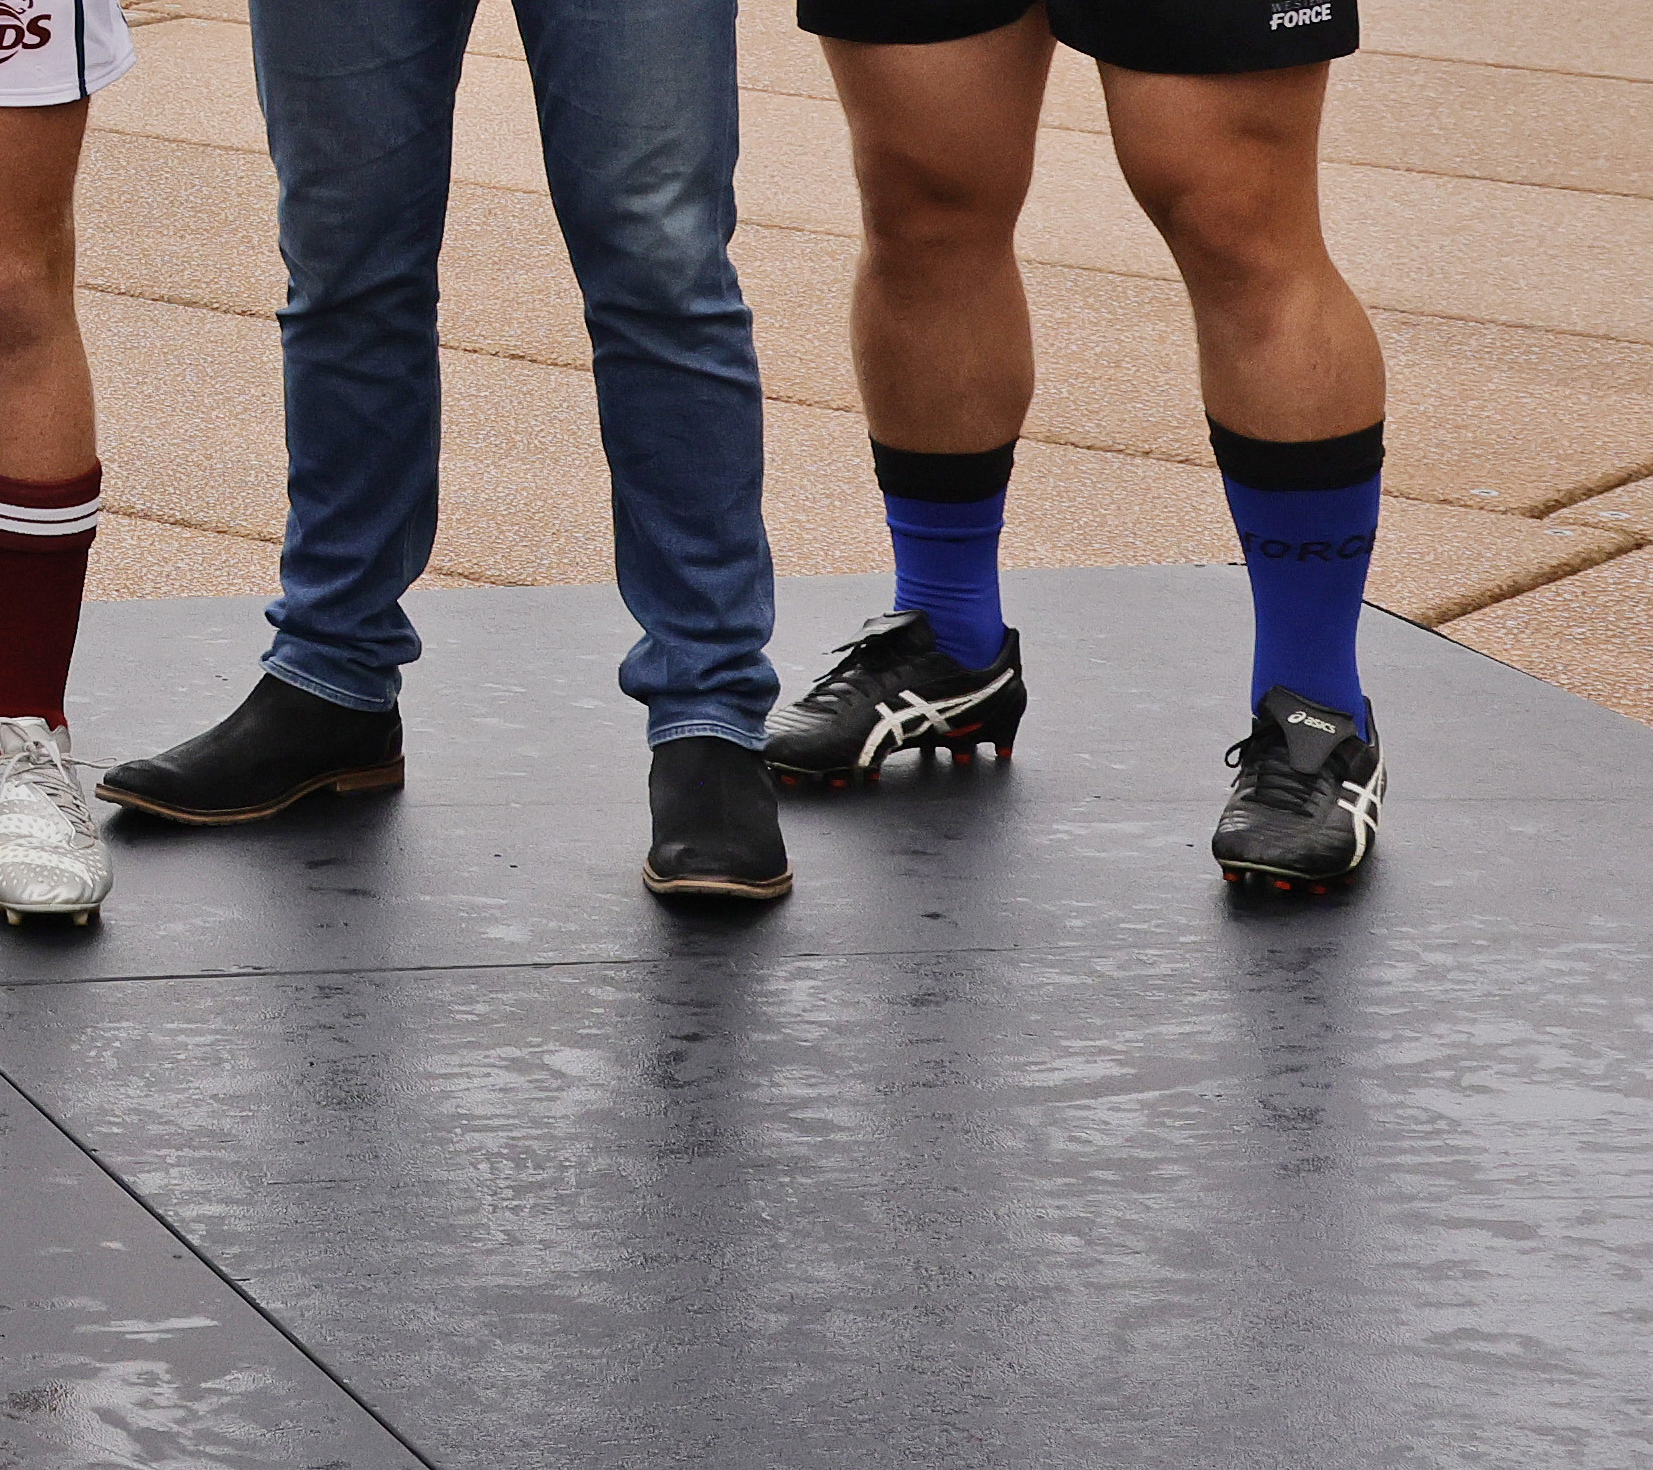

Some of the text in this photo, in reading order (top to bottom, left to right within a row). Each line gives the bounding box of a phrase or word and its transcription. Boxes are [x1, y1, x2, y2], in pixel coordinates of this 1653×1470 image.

[1269, 3, 1332, 31] FORCE
[1244, 527, 1376, 561] FORC
[1303, 716, 1336, 734] asics
